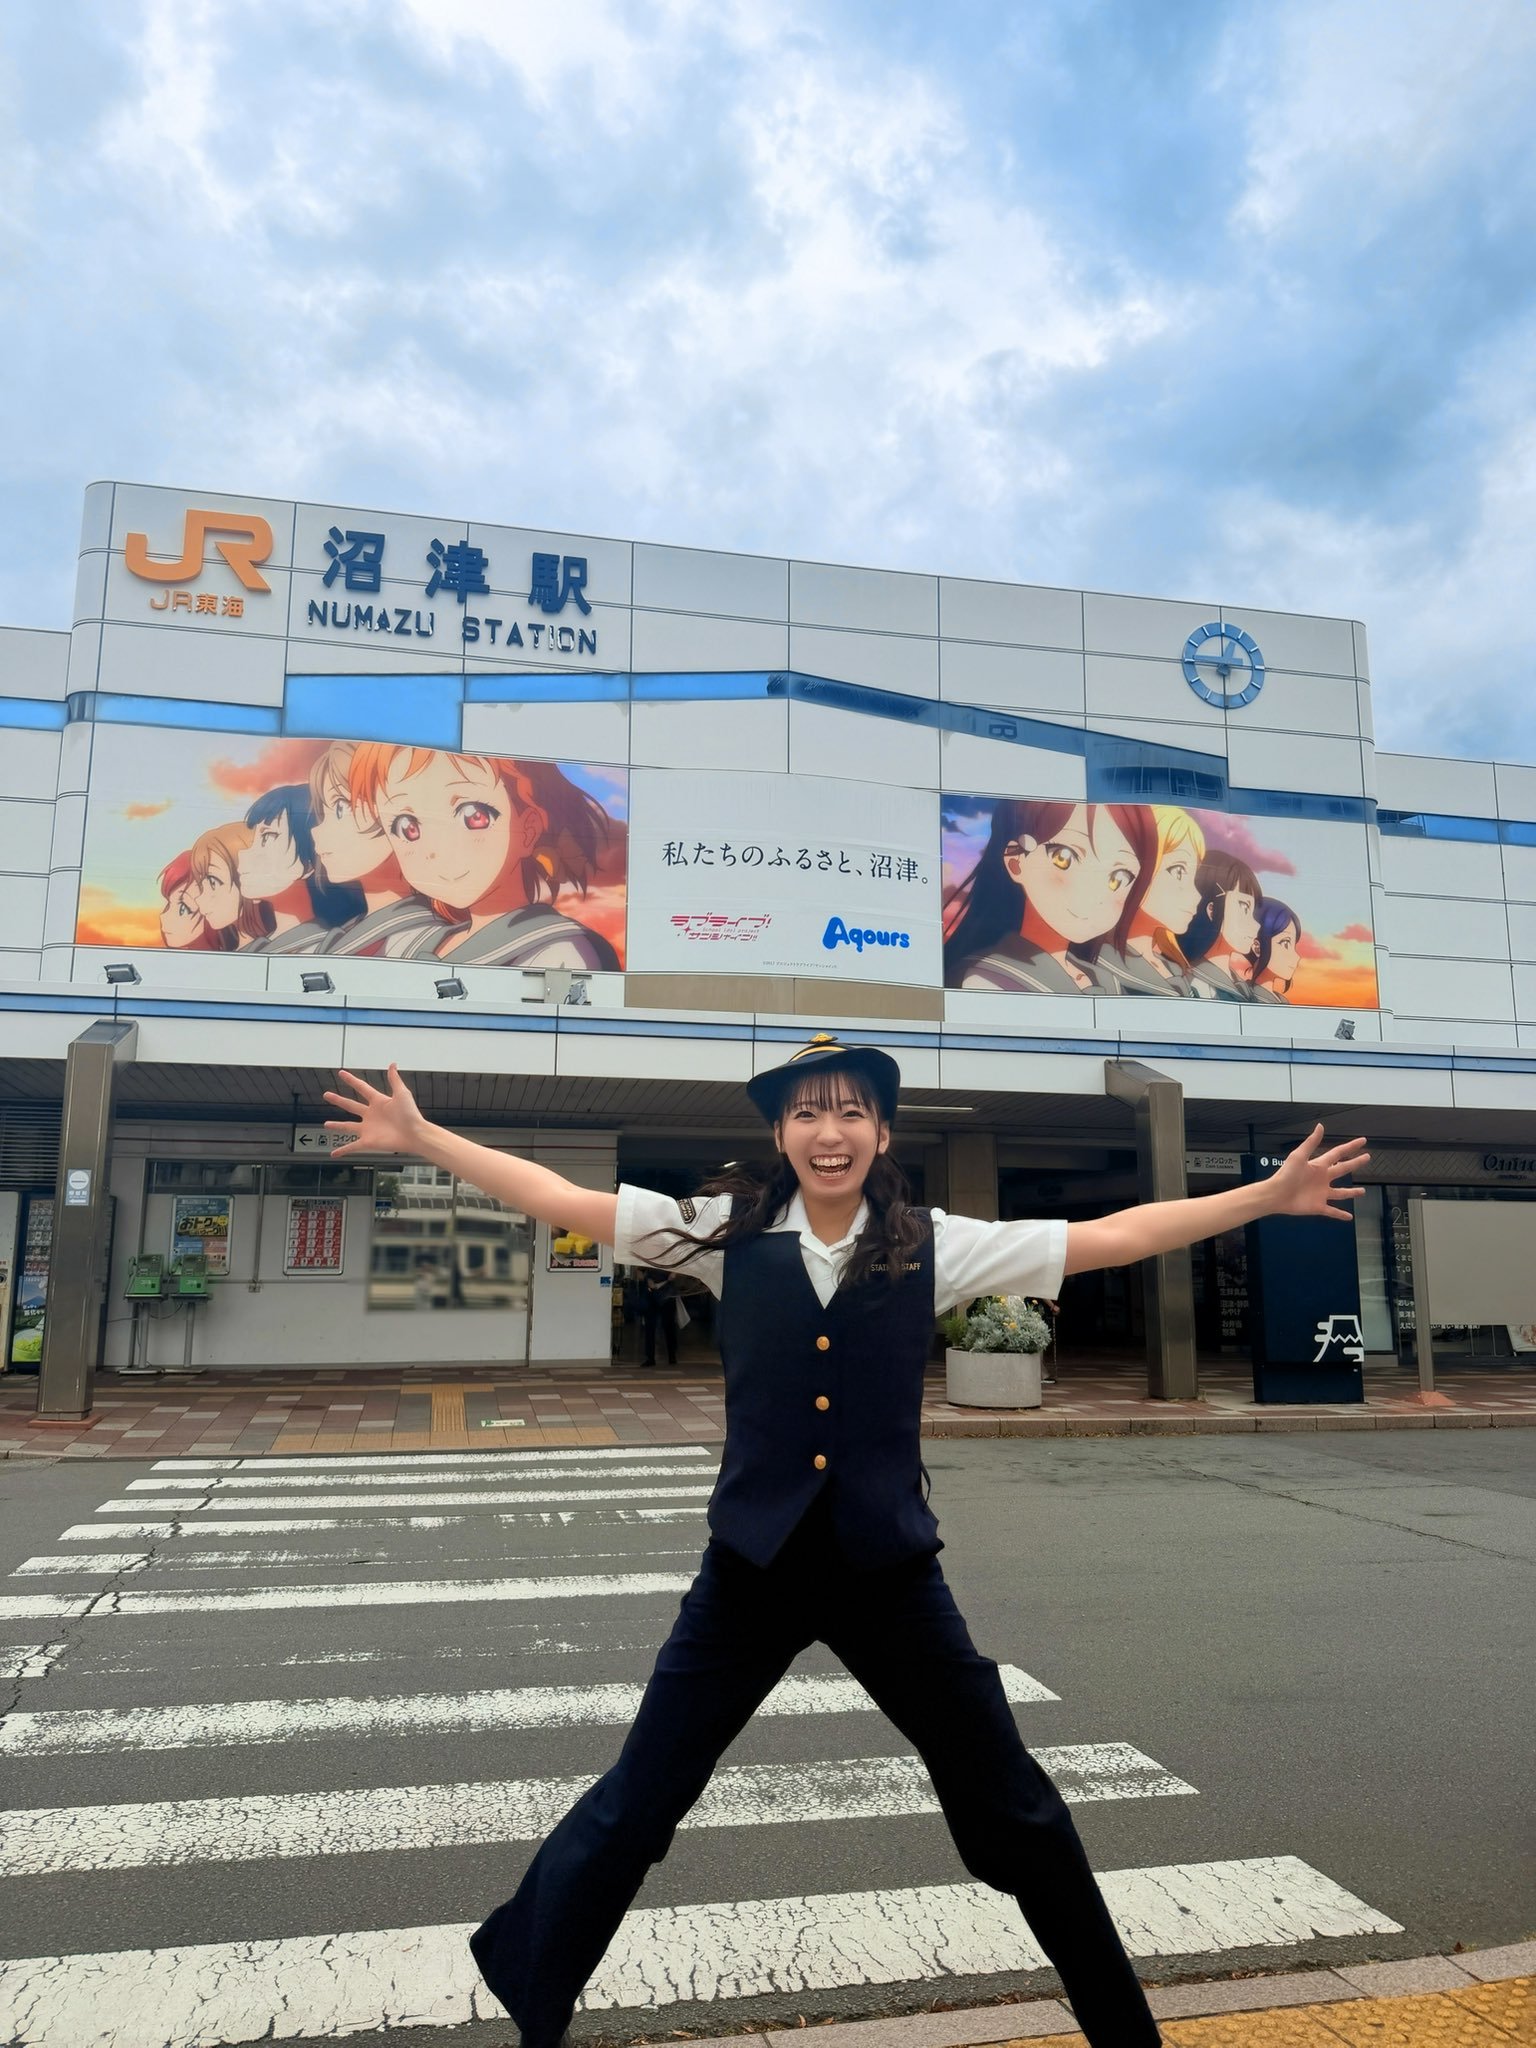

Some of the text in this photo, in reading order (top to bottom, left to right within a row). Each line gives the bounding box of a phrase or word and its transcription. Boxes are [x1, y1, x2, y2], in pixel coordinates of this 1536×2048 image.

[125, 509, 273, 593] JR
[322, 526, 592, 616] 沼津駅
[150, 589, 244, 618] JR東海
[307, 599, 597, 655] NUMAZU STATION
[662, 841, 929, 885] 私たちのふるさと、沼津。
[822, 916, 911, 953] Aqours
